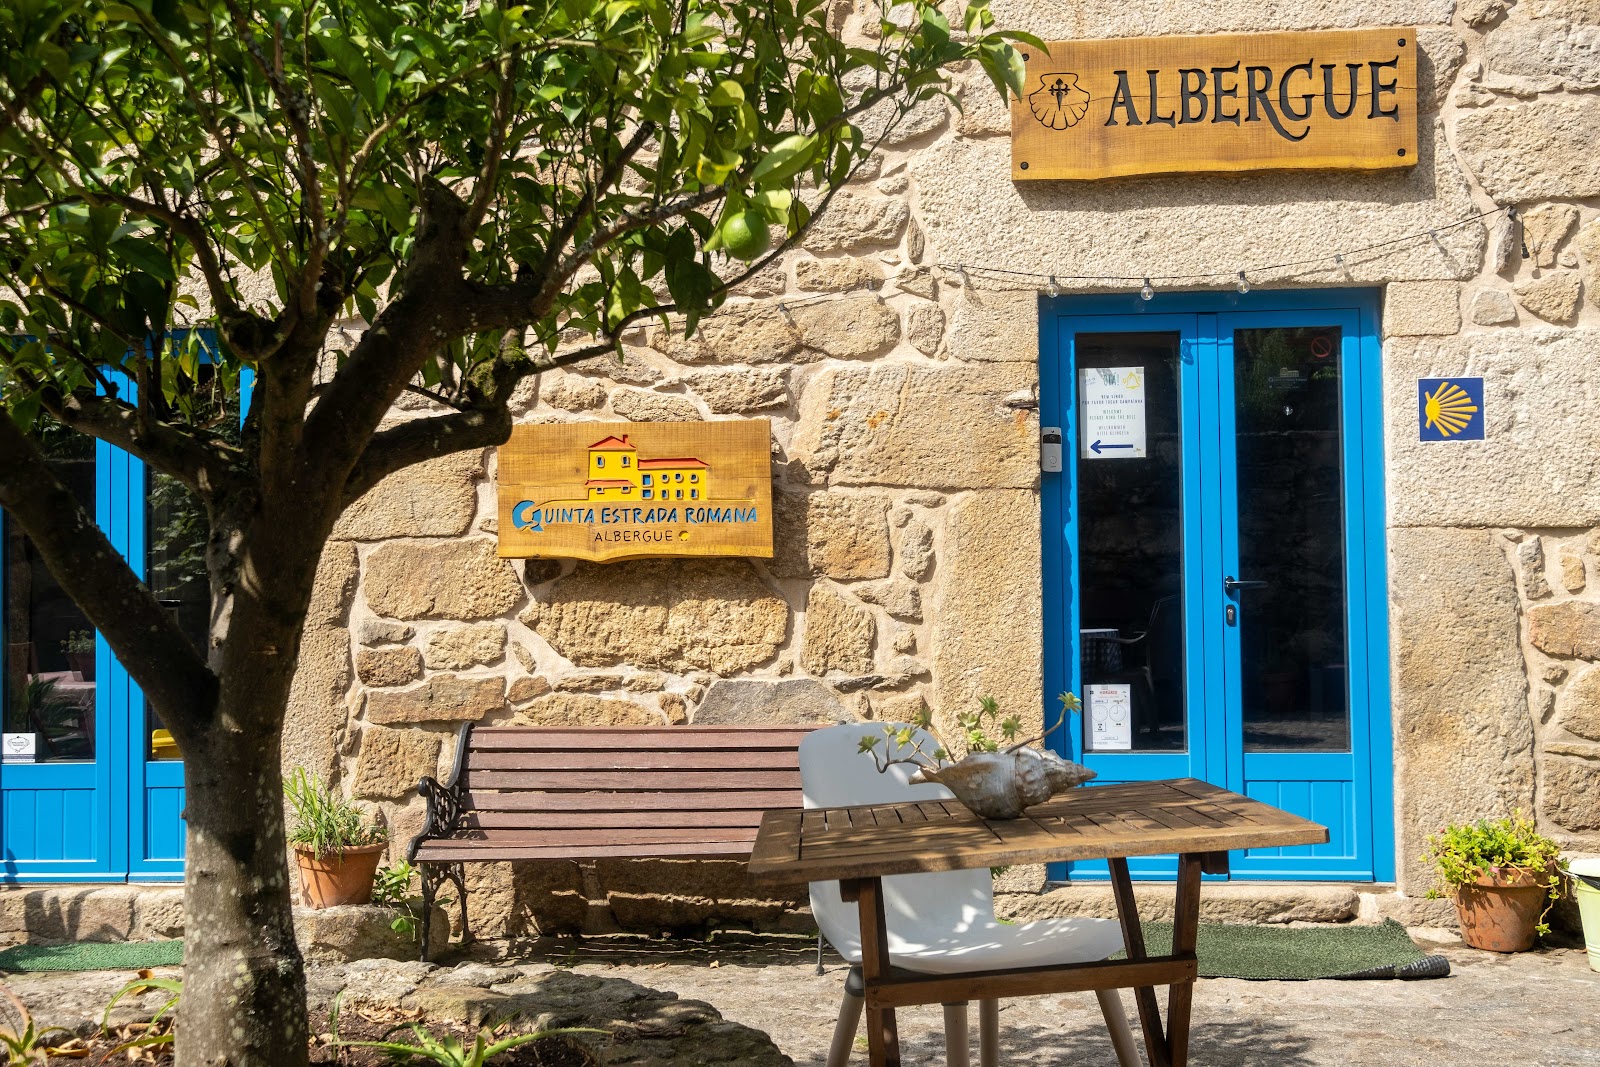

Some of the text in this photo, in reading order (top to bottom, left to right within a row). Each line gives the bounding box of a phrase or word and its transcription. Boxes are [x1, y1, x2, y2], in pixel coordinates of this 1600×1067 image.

[1103, 55, 1399, 142] ALBERGUE
[512, 499, 758, 532] QUINTA ESTRADA ROMANA
[594, 530, 674, 543] ALBERGUE
